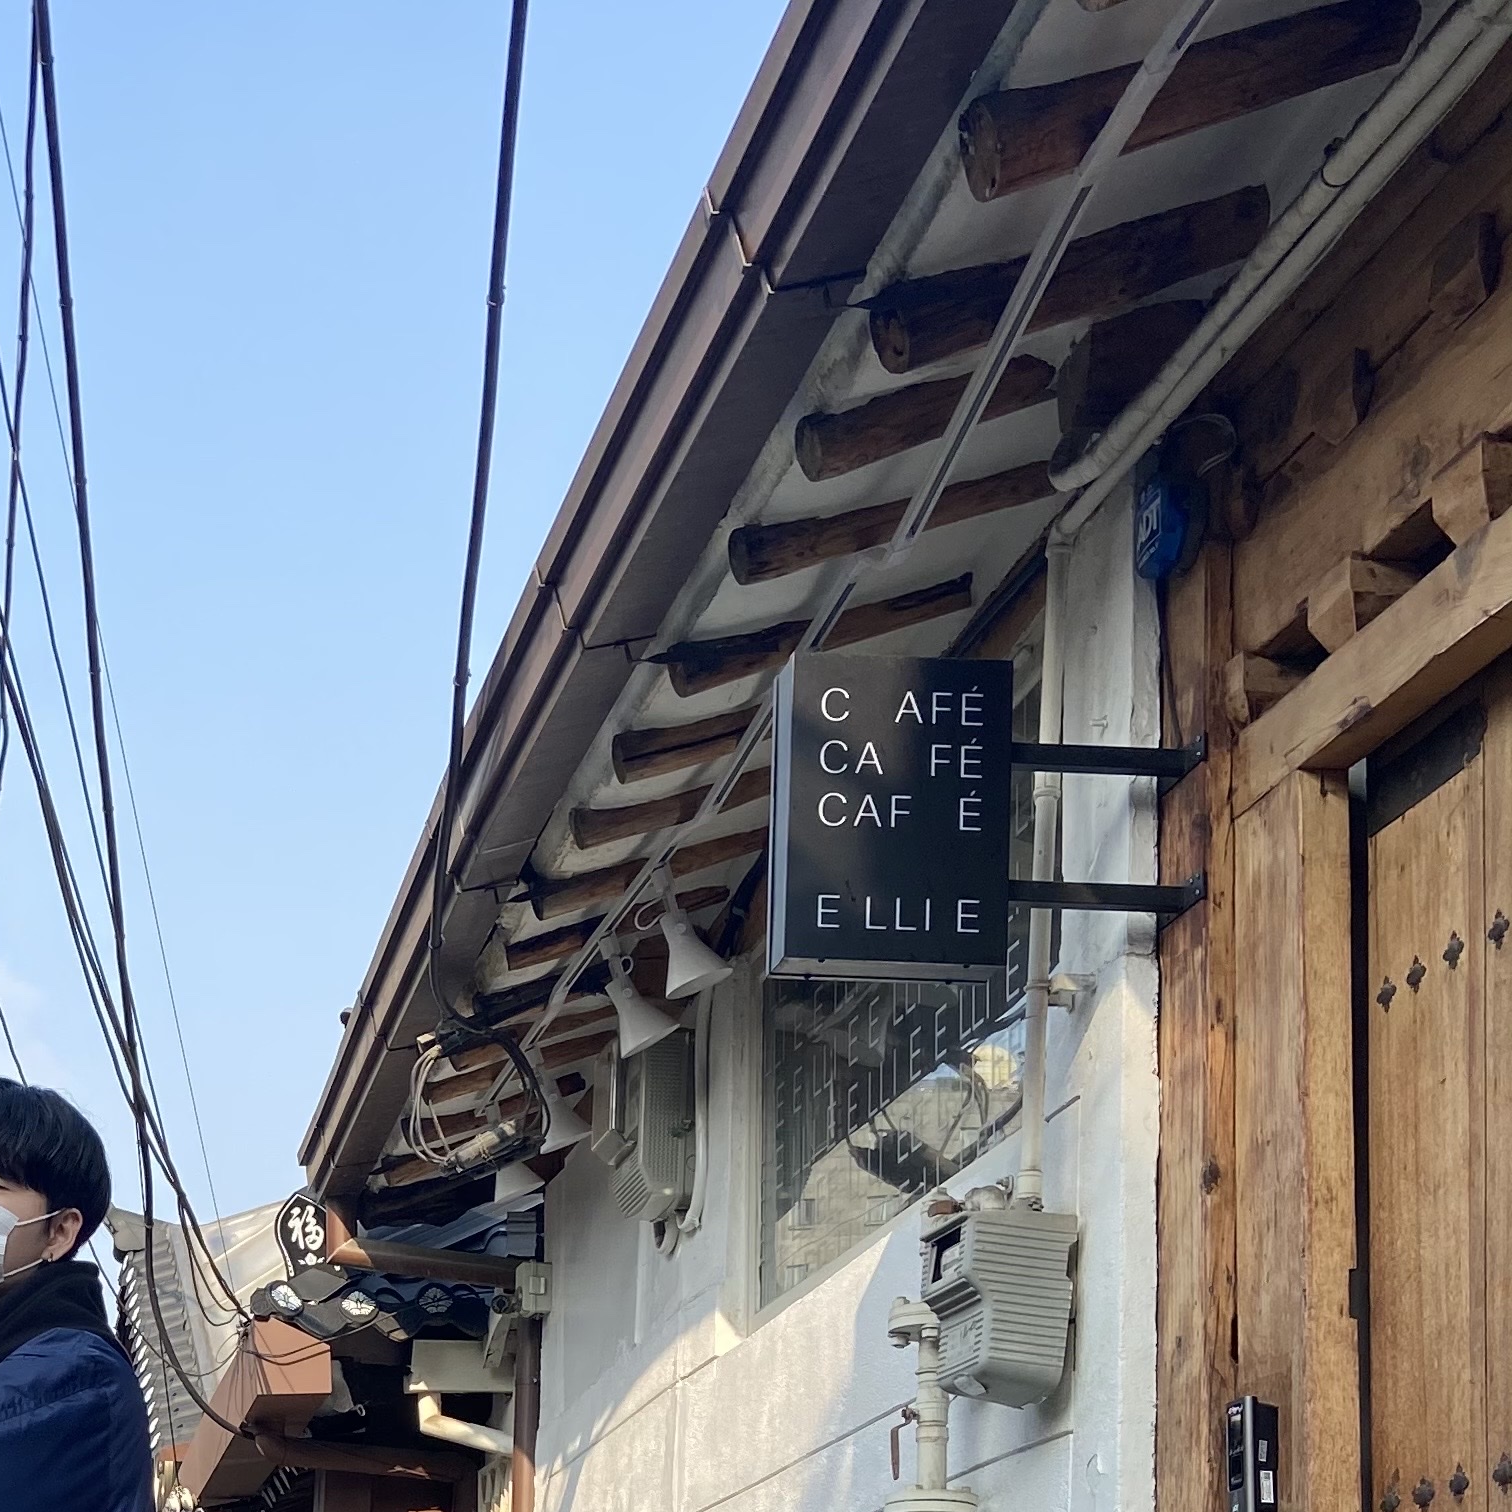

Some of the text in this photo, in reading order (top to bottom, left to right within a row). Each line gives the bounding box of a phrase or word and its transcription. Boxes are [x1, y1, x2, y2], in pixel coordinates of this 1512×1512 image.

[821, 685, 984, 727] C AFÉ
[819, 738, 983, 779] CA FÉ
[818, 790, 982, 831] CAF É
[288, 1205, 325, 1251] 福
